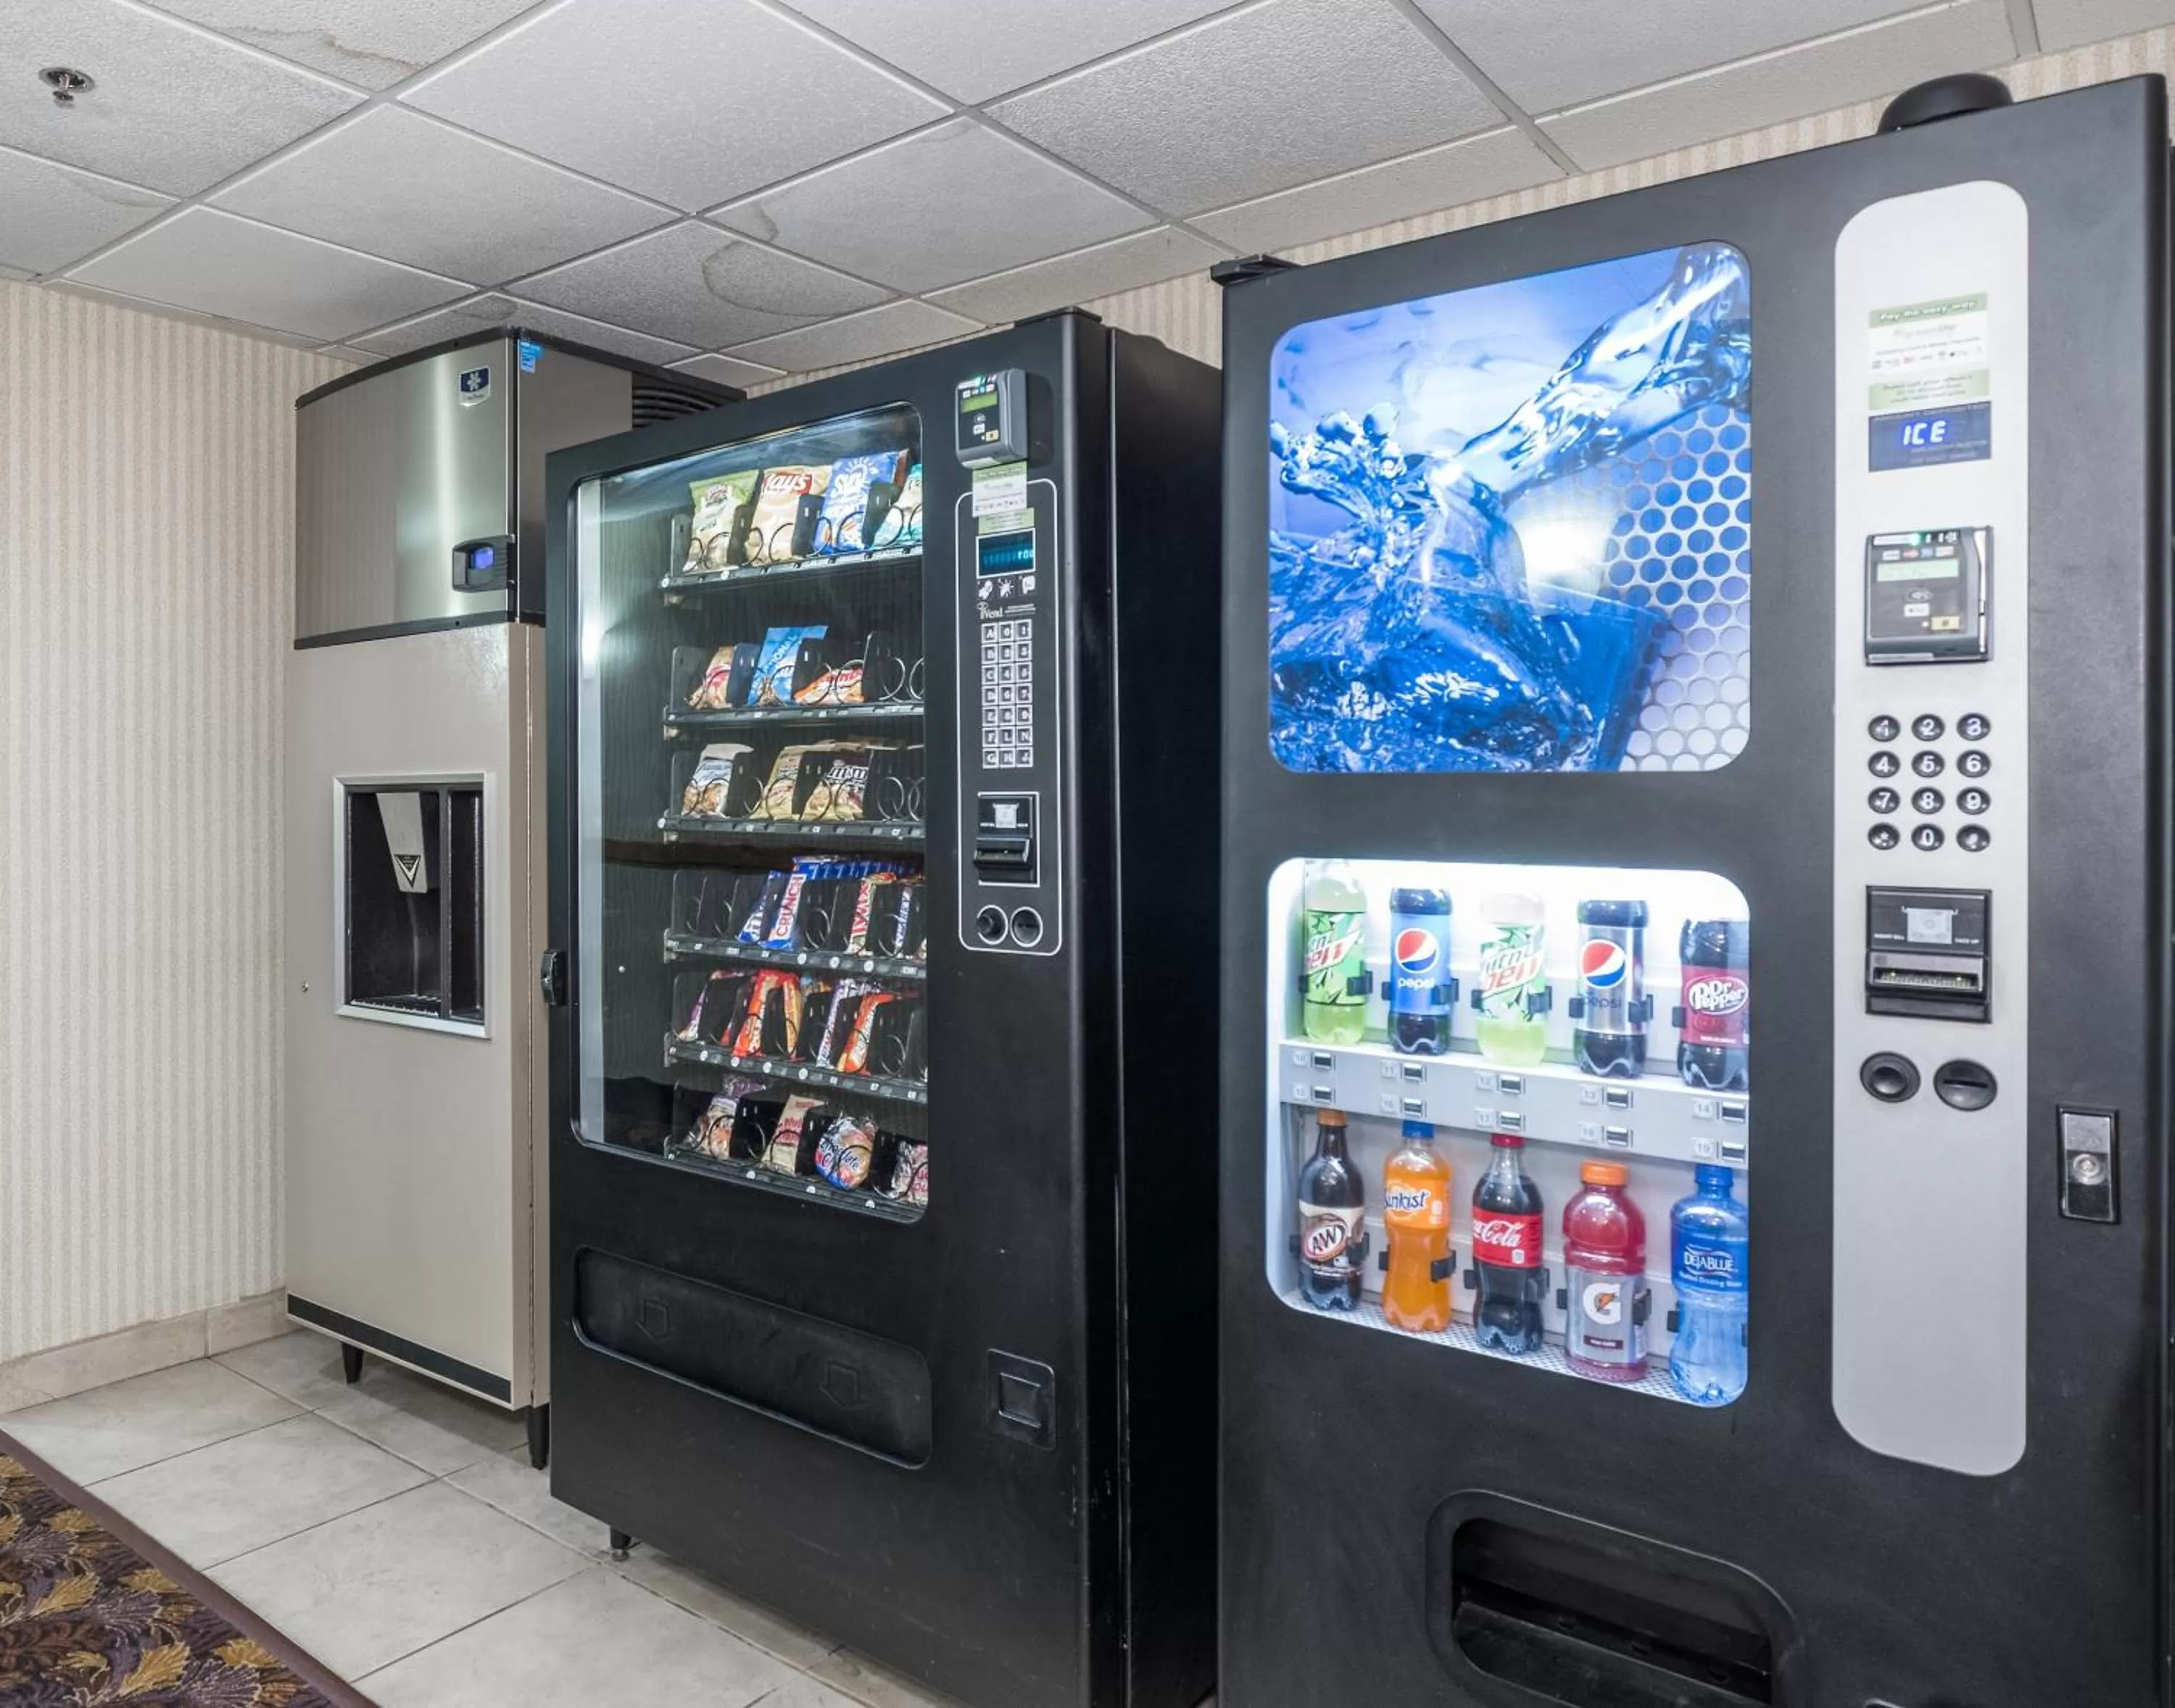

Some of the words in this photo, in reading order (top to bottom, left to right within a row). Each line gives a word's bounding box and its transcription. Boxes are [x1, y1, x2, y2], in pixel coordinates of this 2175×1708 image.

[1903, 420, 1946, 445] ICE
[1922, 718, 1935, 736] 2
[1876, 755, 1889, 772] 4
[1922, 755, 1935, 772] 5
[1966, 755, 1981, 772] 6
[1878, 792, 1891, 808] 7
[1922, 792, 1935, 810] 8
[1966, 792, 1981, 810] 9
[1922, 829, 1934, 846] 0
[776, 876, 804, 937] CRUNCH
[1397, 977, 1435, 992] pepsi
[1709, 980, 1732, 996] Dr
[1694, 982, 1745, 1011] Pepper
[1583, 1282, 1622, 1324] G
